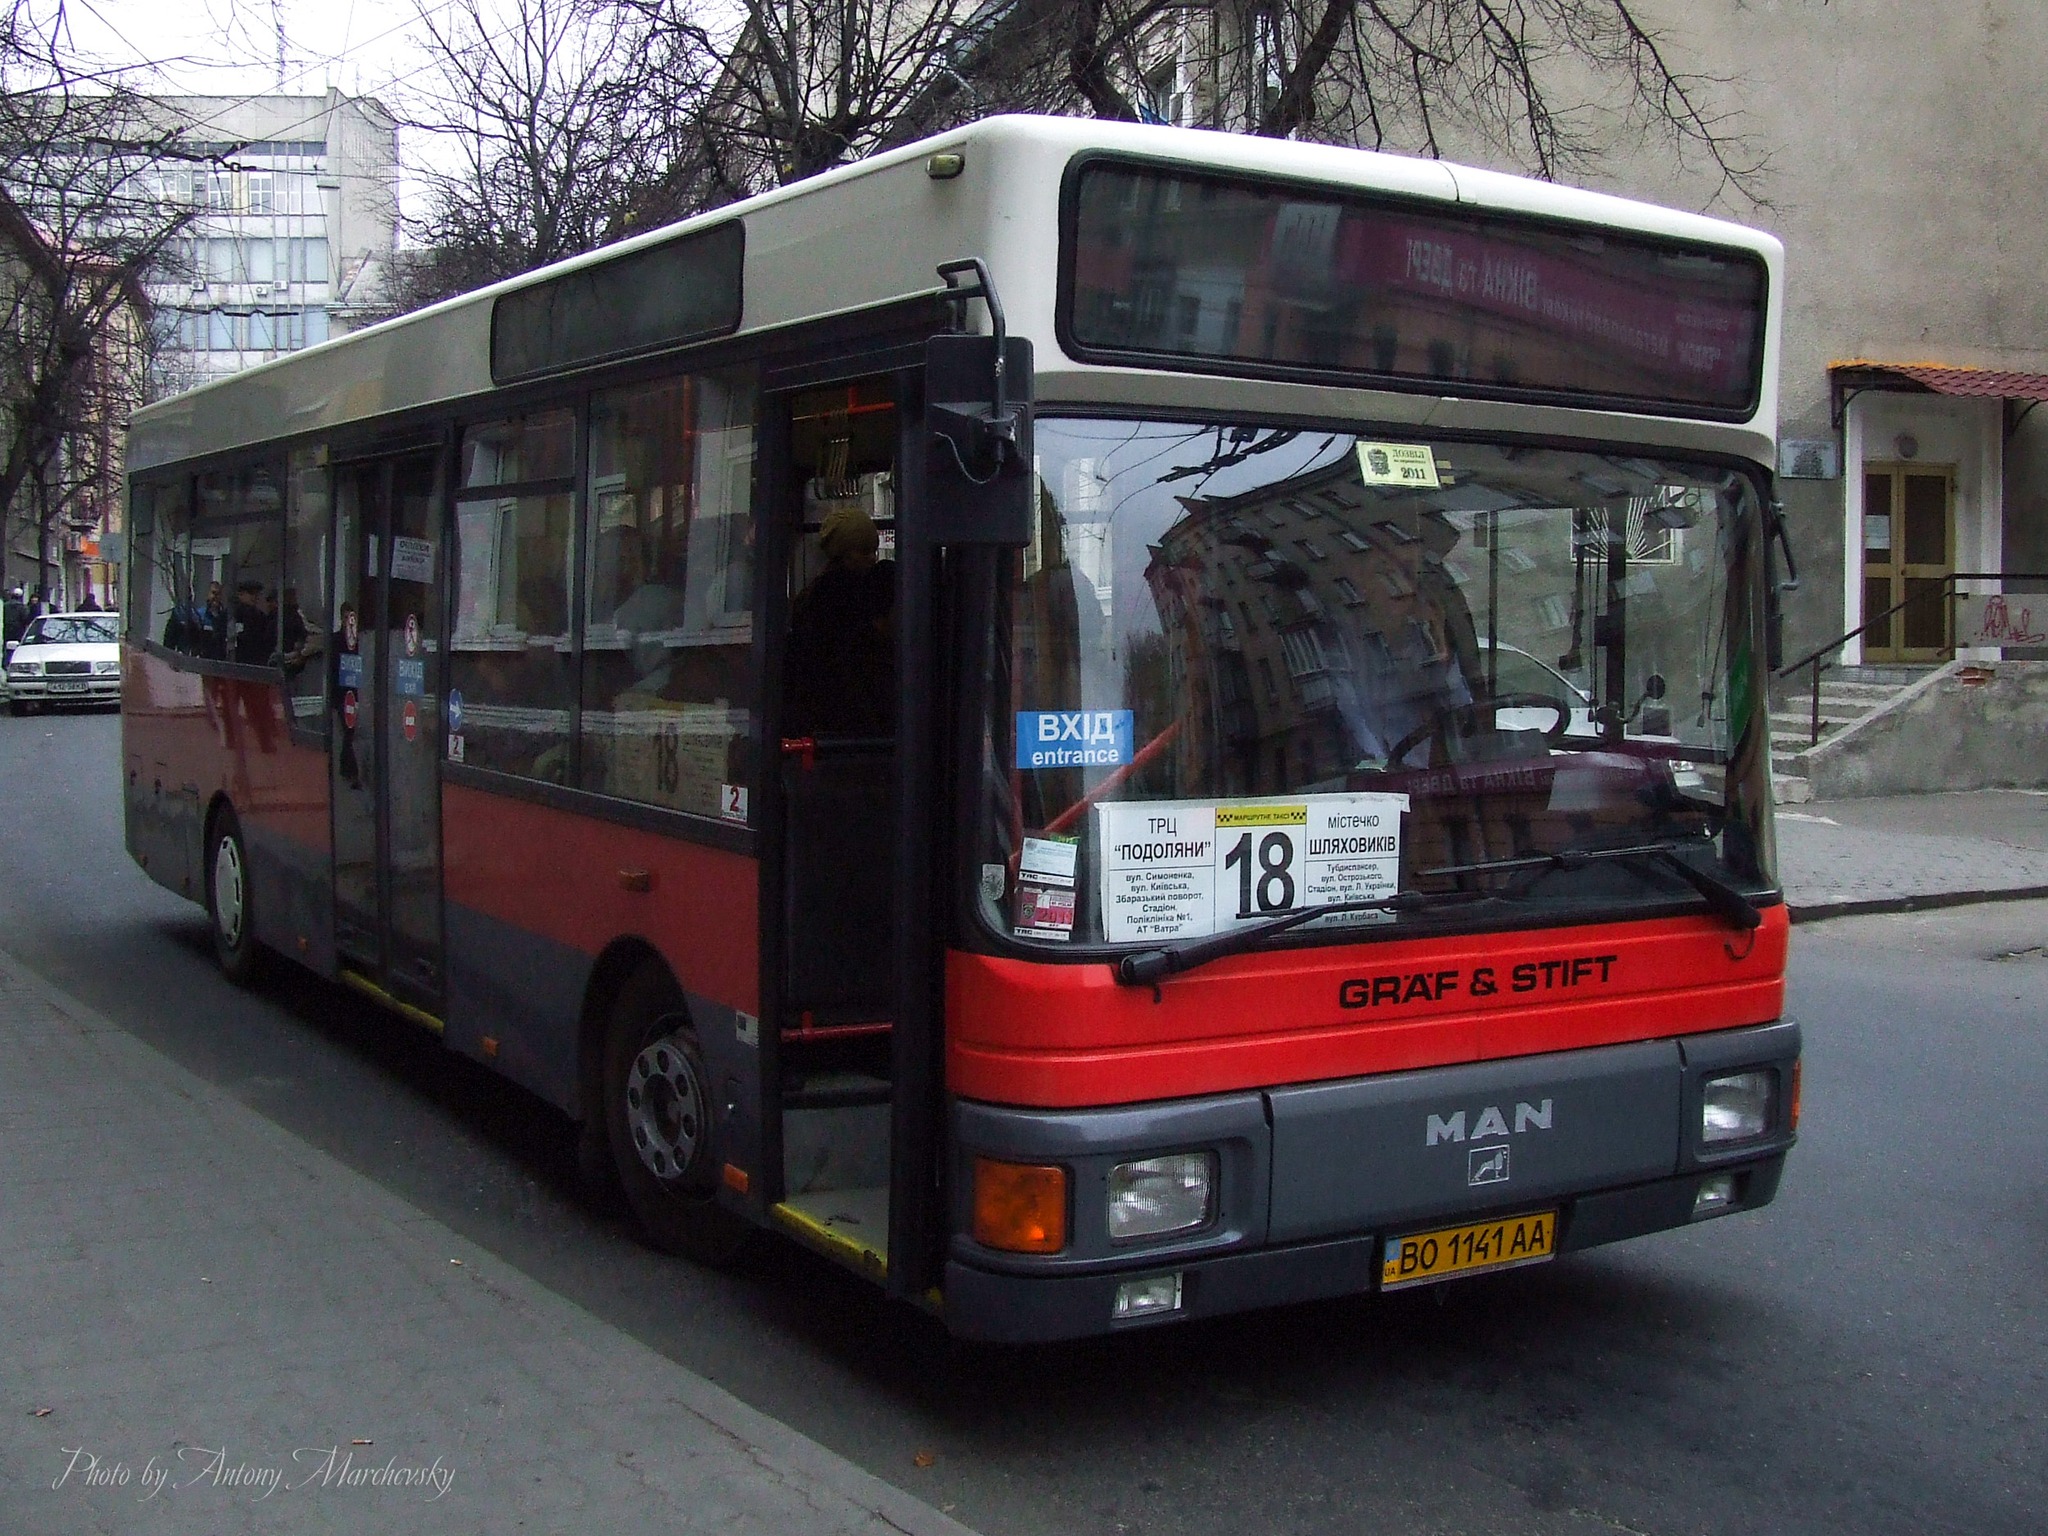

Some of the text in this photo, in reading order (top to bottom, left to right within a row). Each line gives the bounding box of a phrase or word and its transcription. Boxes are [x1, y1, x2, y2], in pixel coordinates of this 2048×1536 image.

[1400, 467, 1426, 479] 2011
[1038, 713, 1115, 745] ВХІД
[452, 736, 460, 754] 2
[1032, 747, 1119, 765] entrance
[730, 786, 740, 812] 2
[1148, 818, 1177, 837] ТРЦ
[1328, 812, 1380, 828] містечко
[1114, 841, 1211, 863] “ПОДОЛЯНИ”
[1309, 836, 1396, 856] ШЛЯХОВИКІВ
[1126, 872, 1195, 883] вул. Симоненка,
[1225, 832, 1295, 913] 18
[1321, 875, 1337, 884] вул.
[1131, 882, 1190, 894] вул. Київська,
[1115, 892, 1166, 905] Збаразький
[1126, 914, 1175, 924] Поліклініка
[1136, 925, 1149, 934] АТ
[1338, 955, 1618, 1010] GRÄF & STIFT
[1425, 1099, 1553, 1147] MAN
[1447, 1225, 1506, 1266] 1141
[1509, 1219, 1545, 1256] AA
